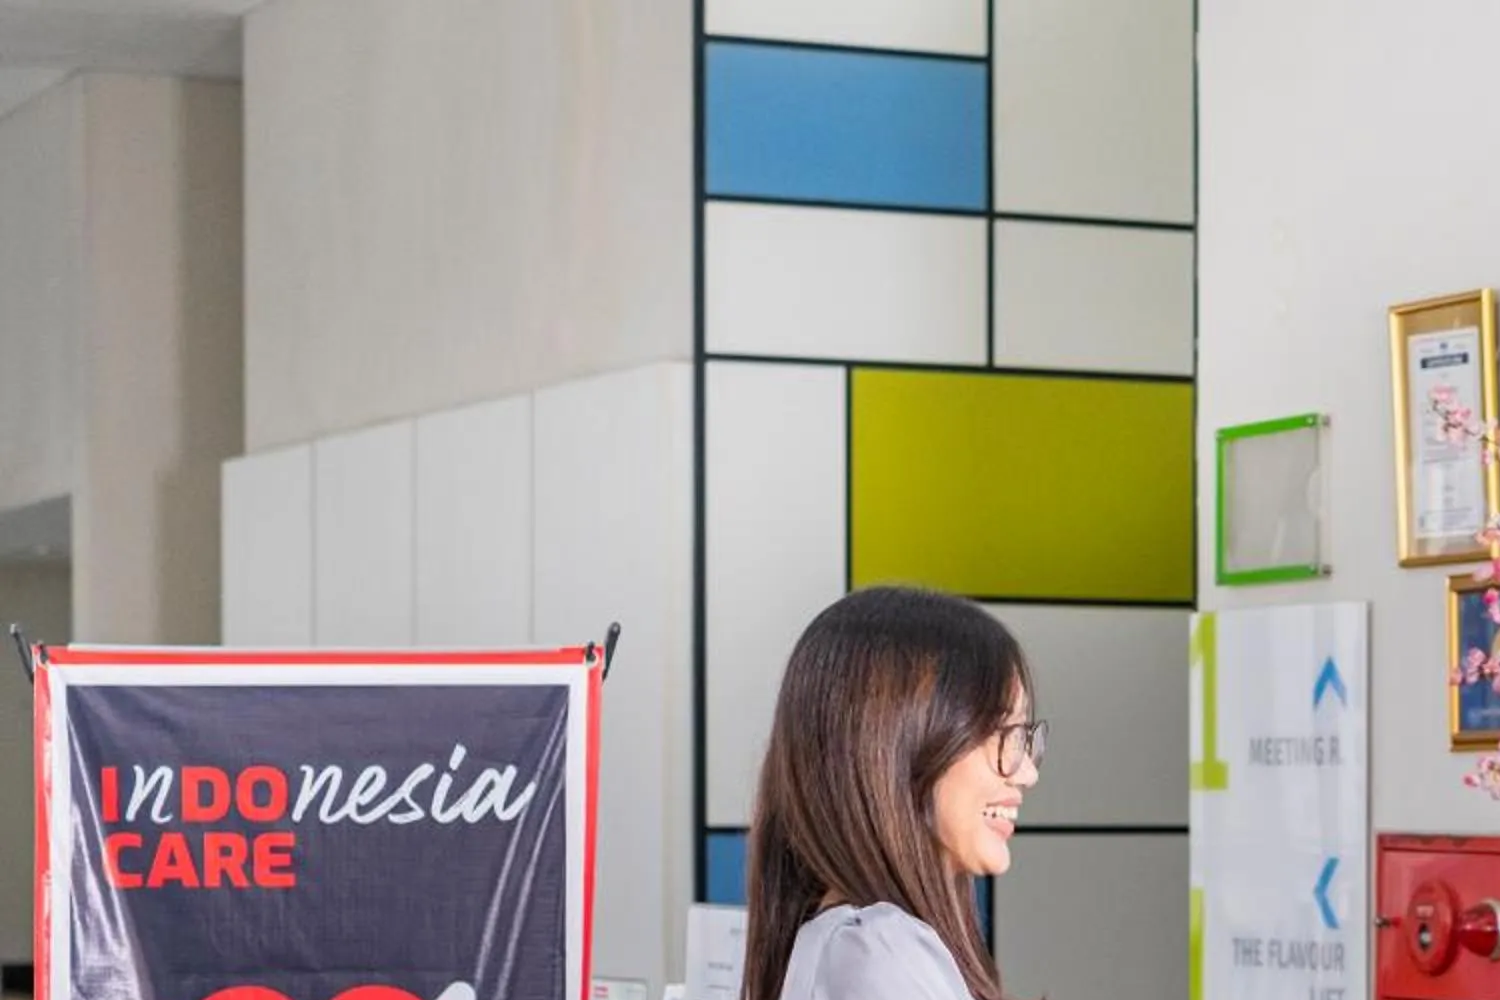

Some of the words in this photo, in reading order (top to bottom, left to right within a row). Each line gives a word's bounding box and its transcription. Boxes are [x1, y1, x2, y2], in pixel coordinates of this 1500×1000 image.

[1249, 737, 1325, 767] MEETING
[102, 831, 296, 888] CARE
[1233, 937, 1262, 967] THE
[1268, 940, 1345, 974] FLAVOUR
